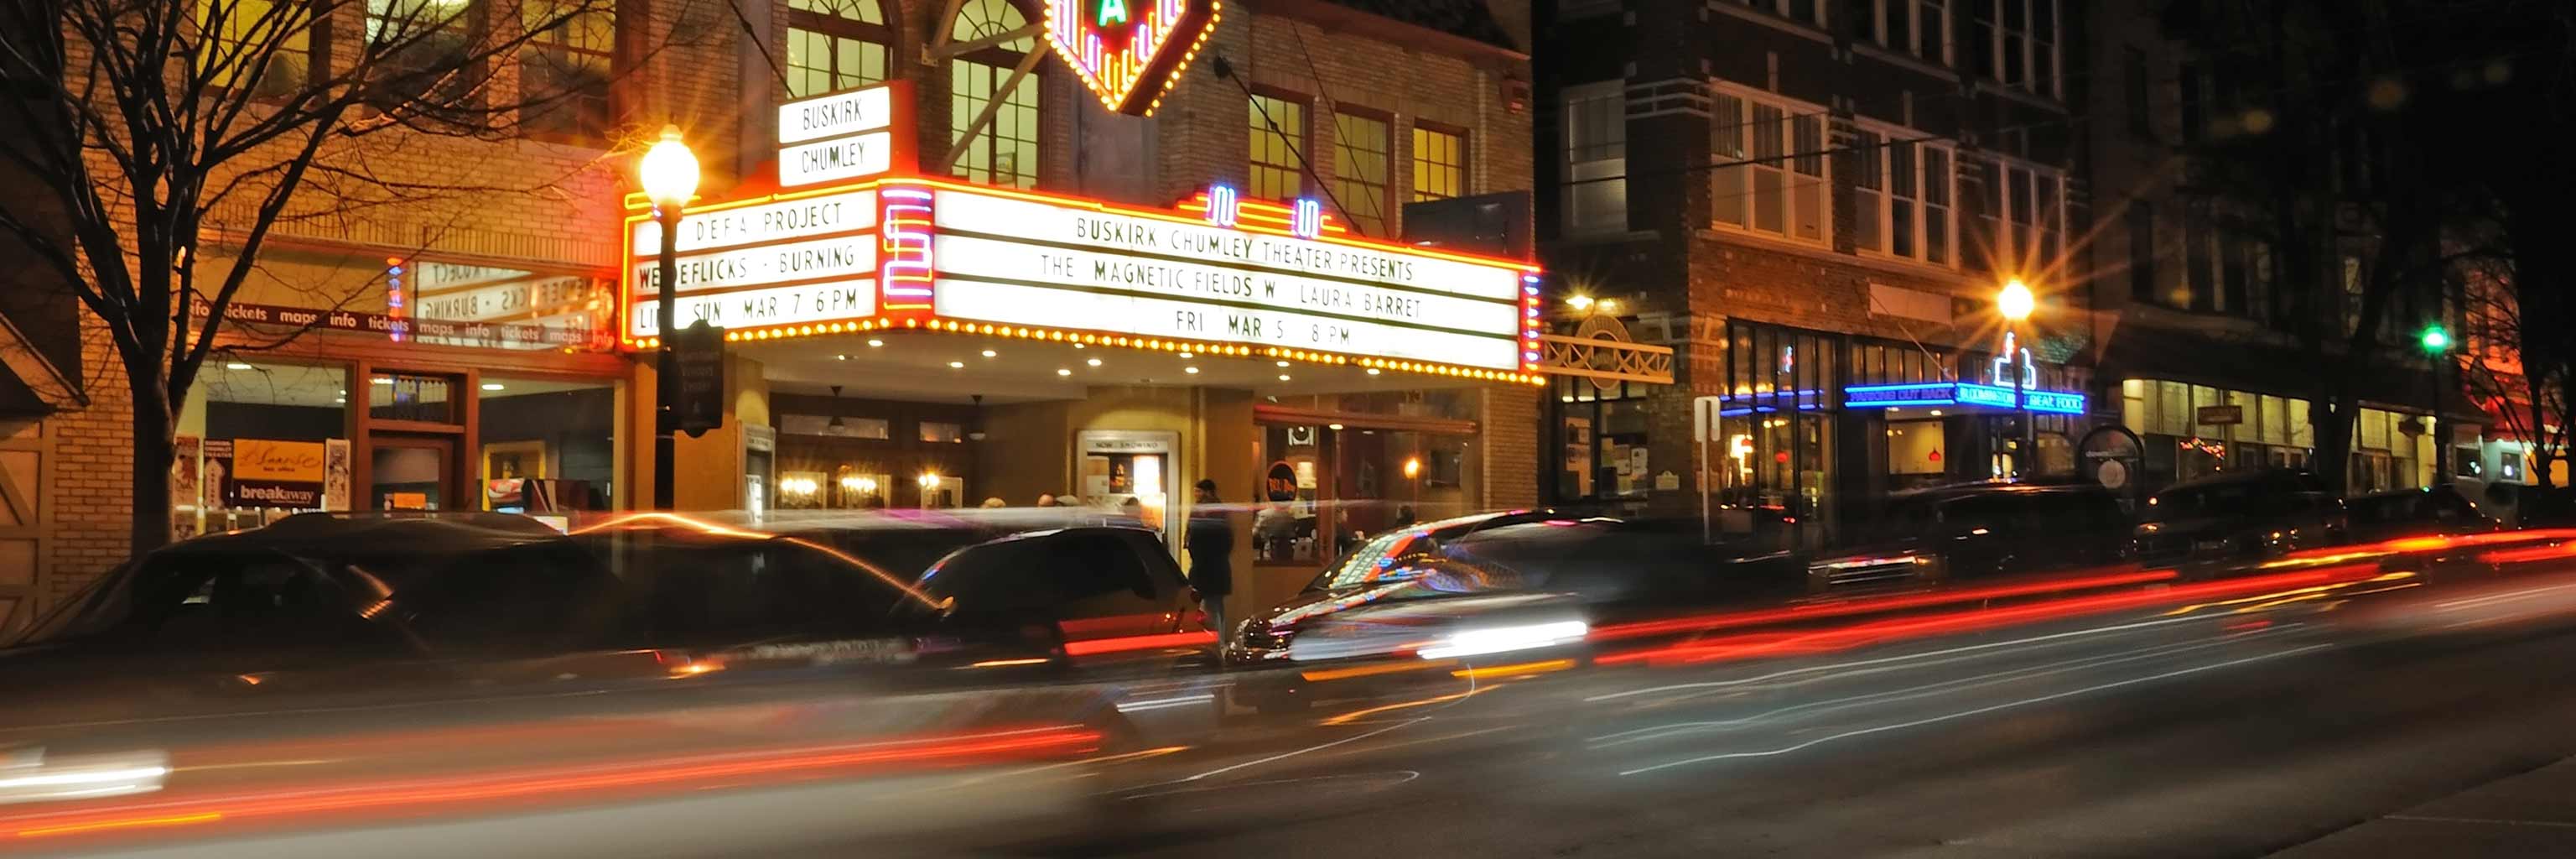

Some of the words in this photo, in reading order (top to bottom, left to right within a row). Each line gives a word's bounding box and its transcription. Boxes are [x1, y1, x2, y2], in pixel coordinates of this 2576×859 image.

[802, 97, 864, 130] BUSKIRK
[802, 141, 865, 174] CHUMLEY
[697, 215, 747, 240] DEFA
[764, 202, 842, 230] PROJECT
[780, 245, 854, 273] BURNING
[1077, 217, 1156, 247] BUSKIRK
[1171, 229, 1253, 258] CHUMLEY
[1264, 241, 1332, 269] THEATER
[1340, 252, 1413, 280] PRESENTS
[1041, 254, 1073, 278] THE
[1094, 259, 1184, 289] MAGNETIC
[1195, 271, 1252, 296] FIELDS
[1265, 279, 1275, 298] W
[1301, 284, 1352, 309] LAURA
[1364, 293, 1420, 318] BARRET
[693, 301, 721, 320] SUN
[744, 297, 777, 319] MAR
[793, 294, 801, 315] 7
[223, 303, 267, 320] ickets
[279, 311, 317, 326] maps
[330, 312, 356, 328] info
[368, 315, 409, 332] tickets
[419, 323, 454, 336] maps
[465, 322, 491, 337] info
[501, 325, 539, 341] tickets
[550, 331, 583, 345] maps
[1176, 310, 1203, 332] FRI
[1228, 315, 1262, 337] MAR
[1277, 320, 1284, 339] 5
[1329, 325, 1350, 345] PM
[2057, 396, 2083, 409] FOOD
[240, 484, 314, 501] breakaway
